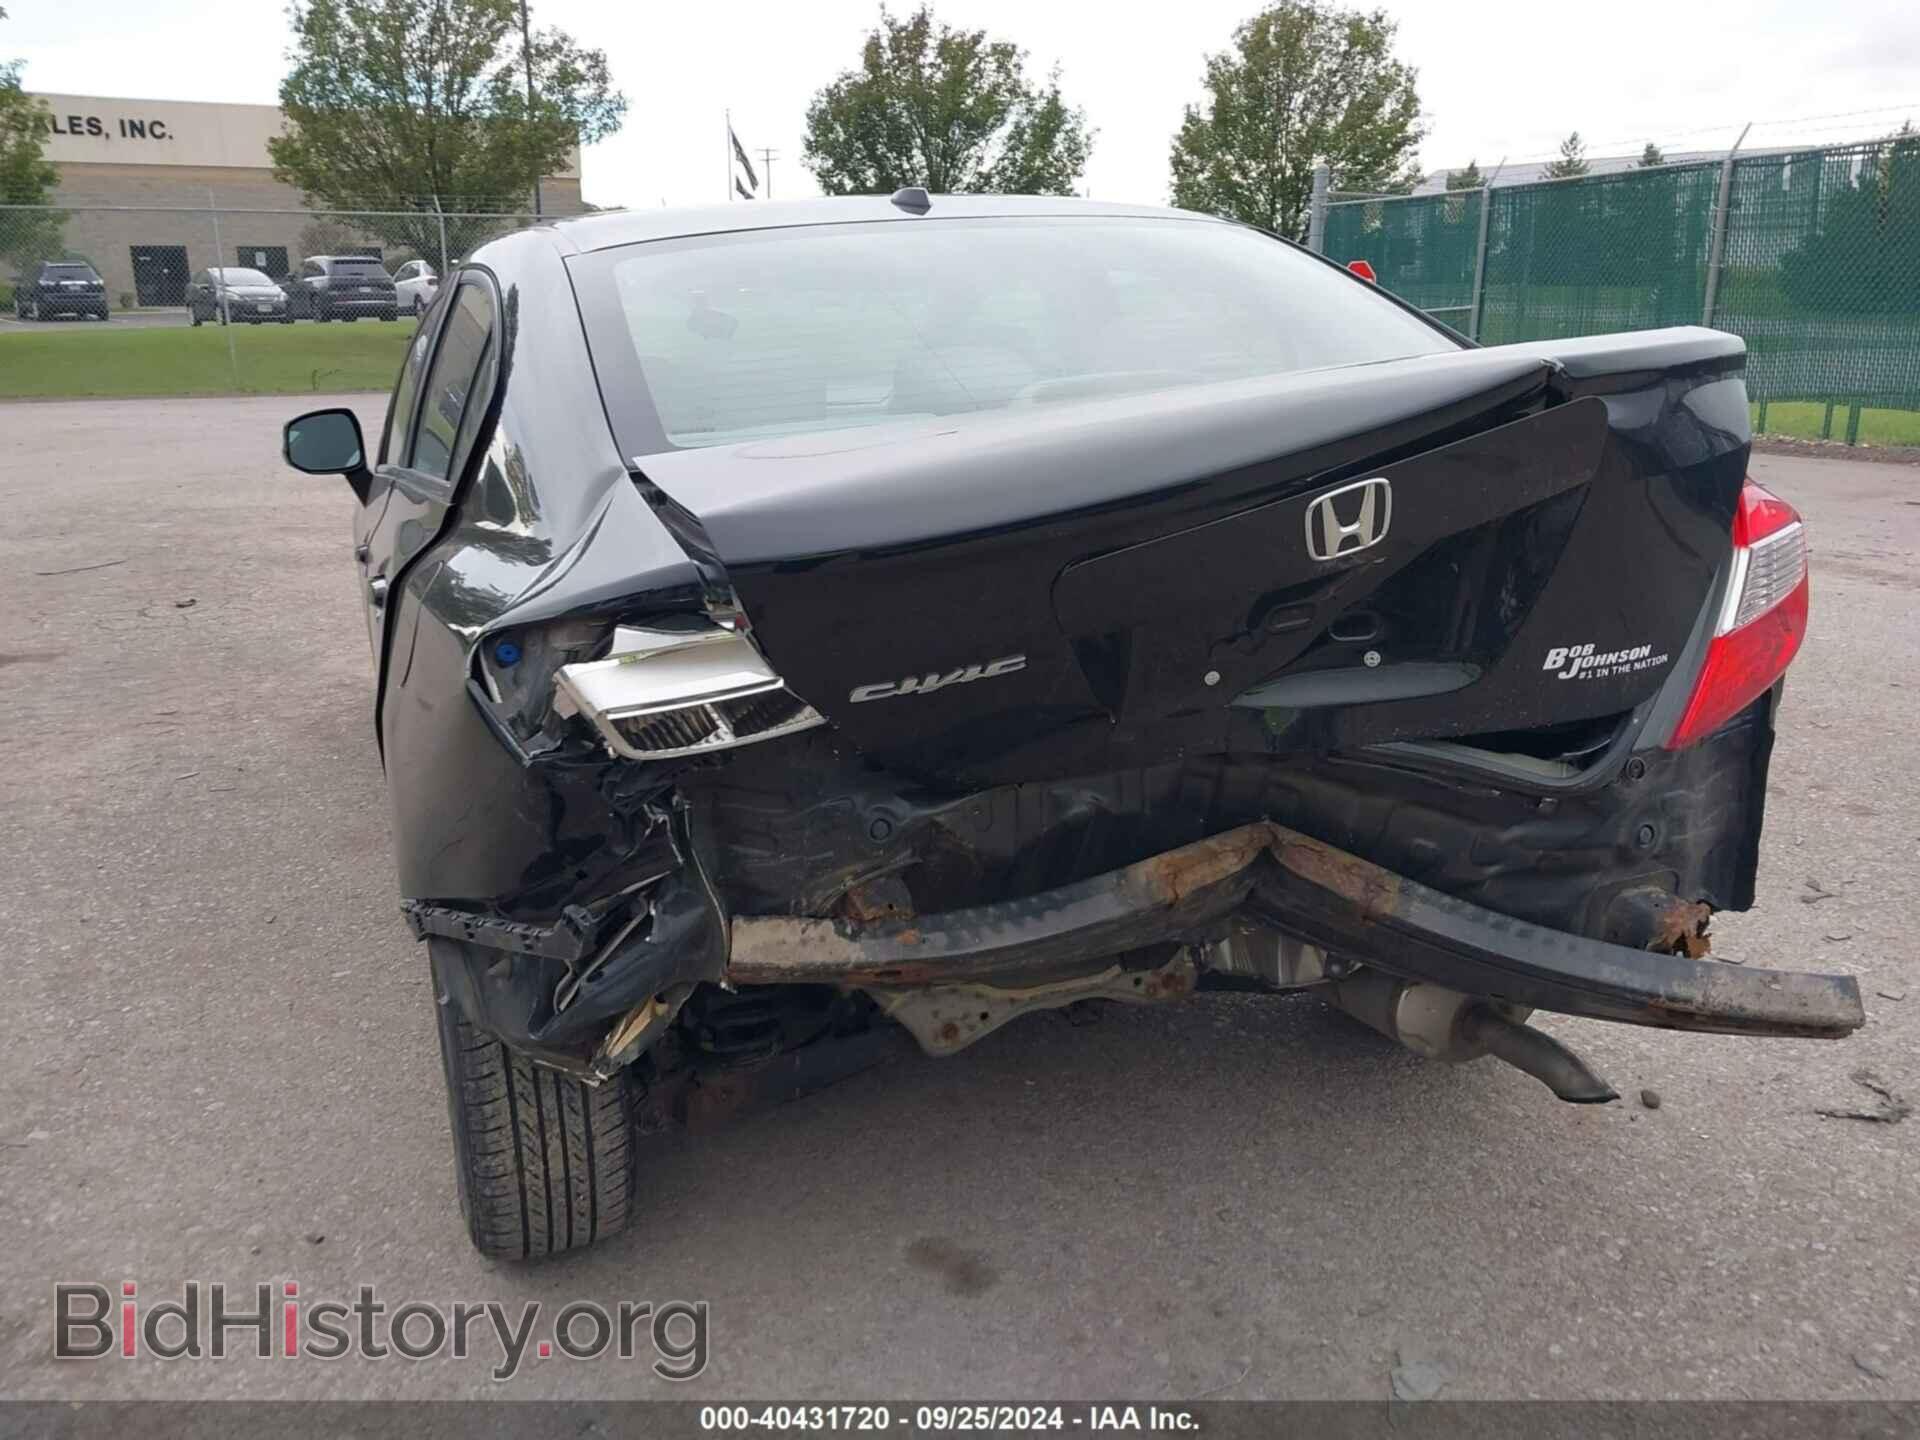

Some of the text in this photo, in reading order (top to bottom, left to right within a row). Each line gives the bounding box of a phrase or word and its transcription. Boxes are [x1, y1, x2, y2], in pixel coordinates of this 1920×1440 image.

[49, 114, 173, 140] LES, INC.
[1543, 643, 1596, 670] BOB
[1558, 644, 1652, 679] JOHNSON
[1578, 653, 1669, 679] #1 IN THE NATION
[849, 653, 1027, 703] CIVIC
